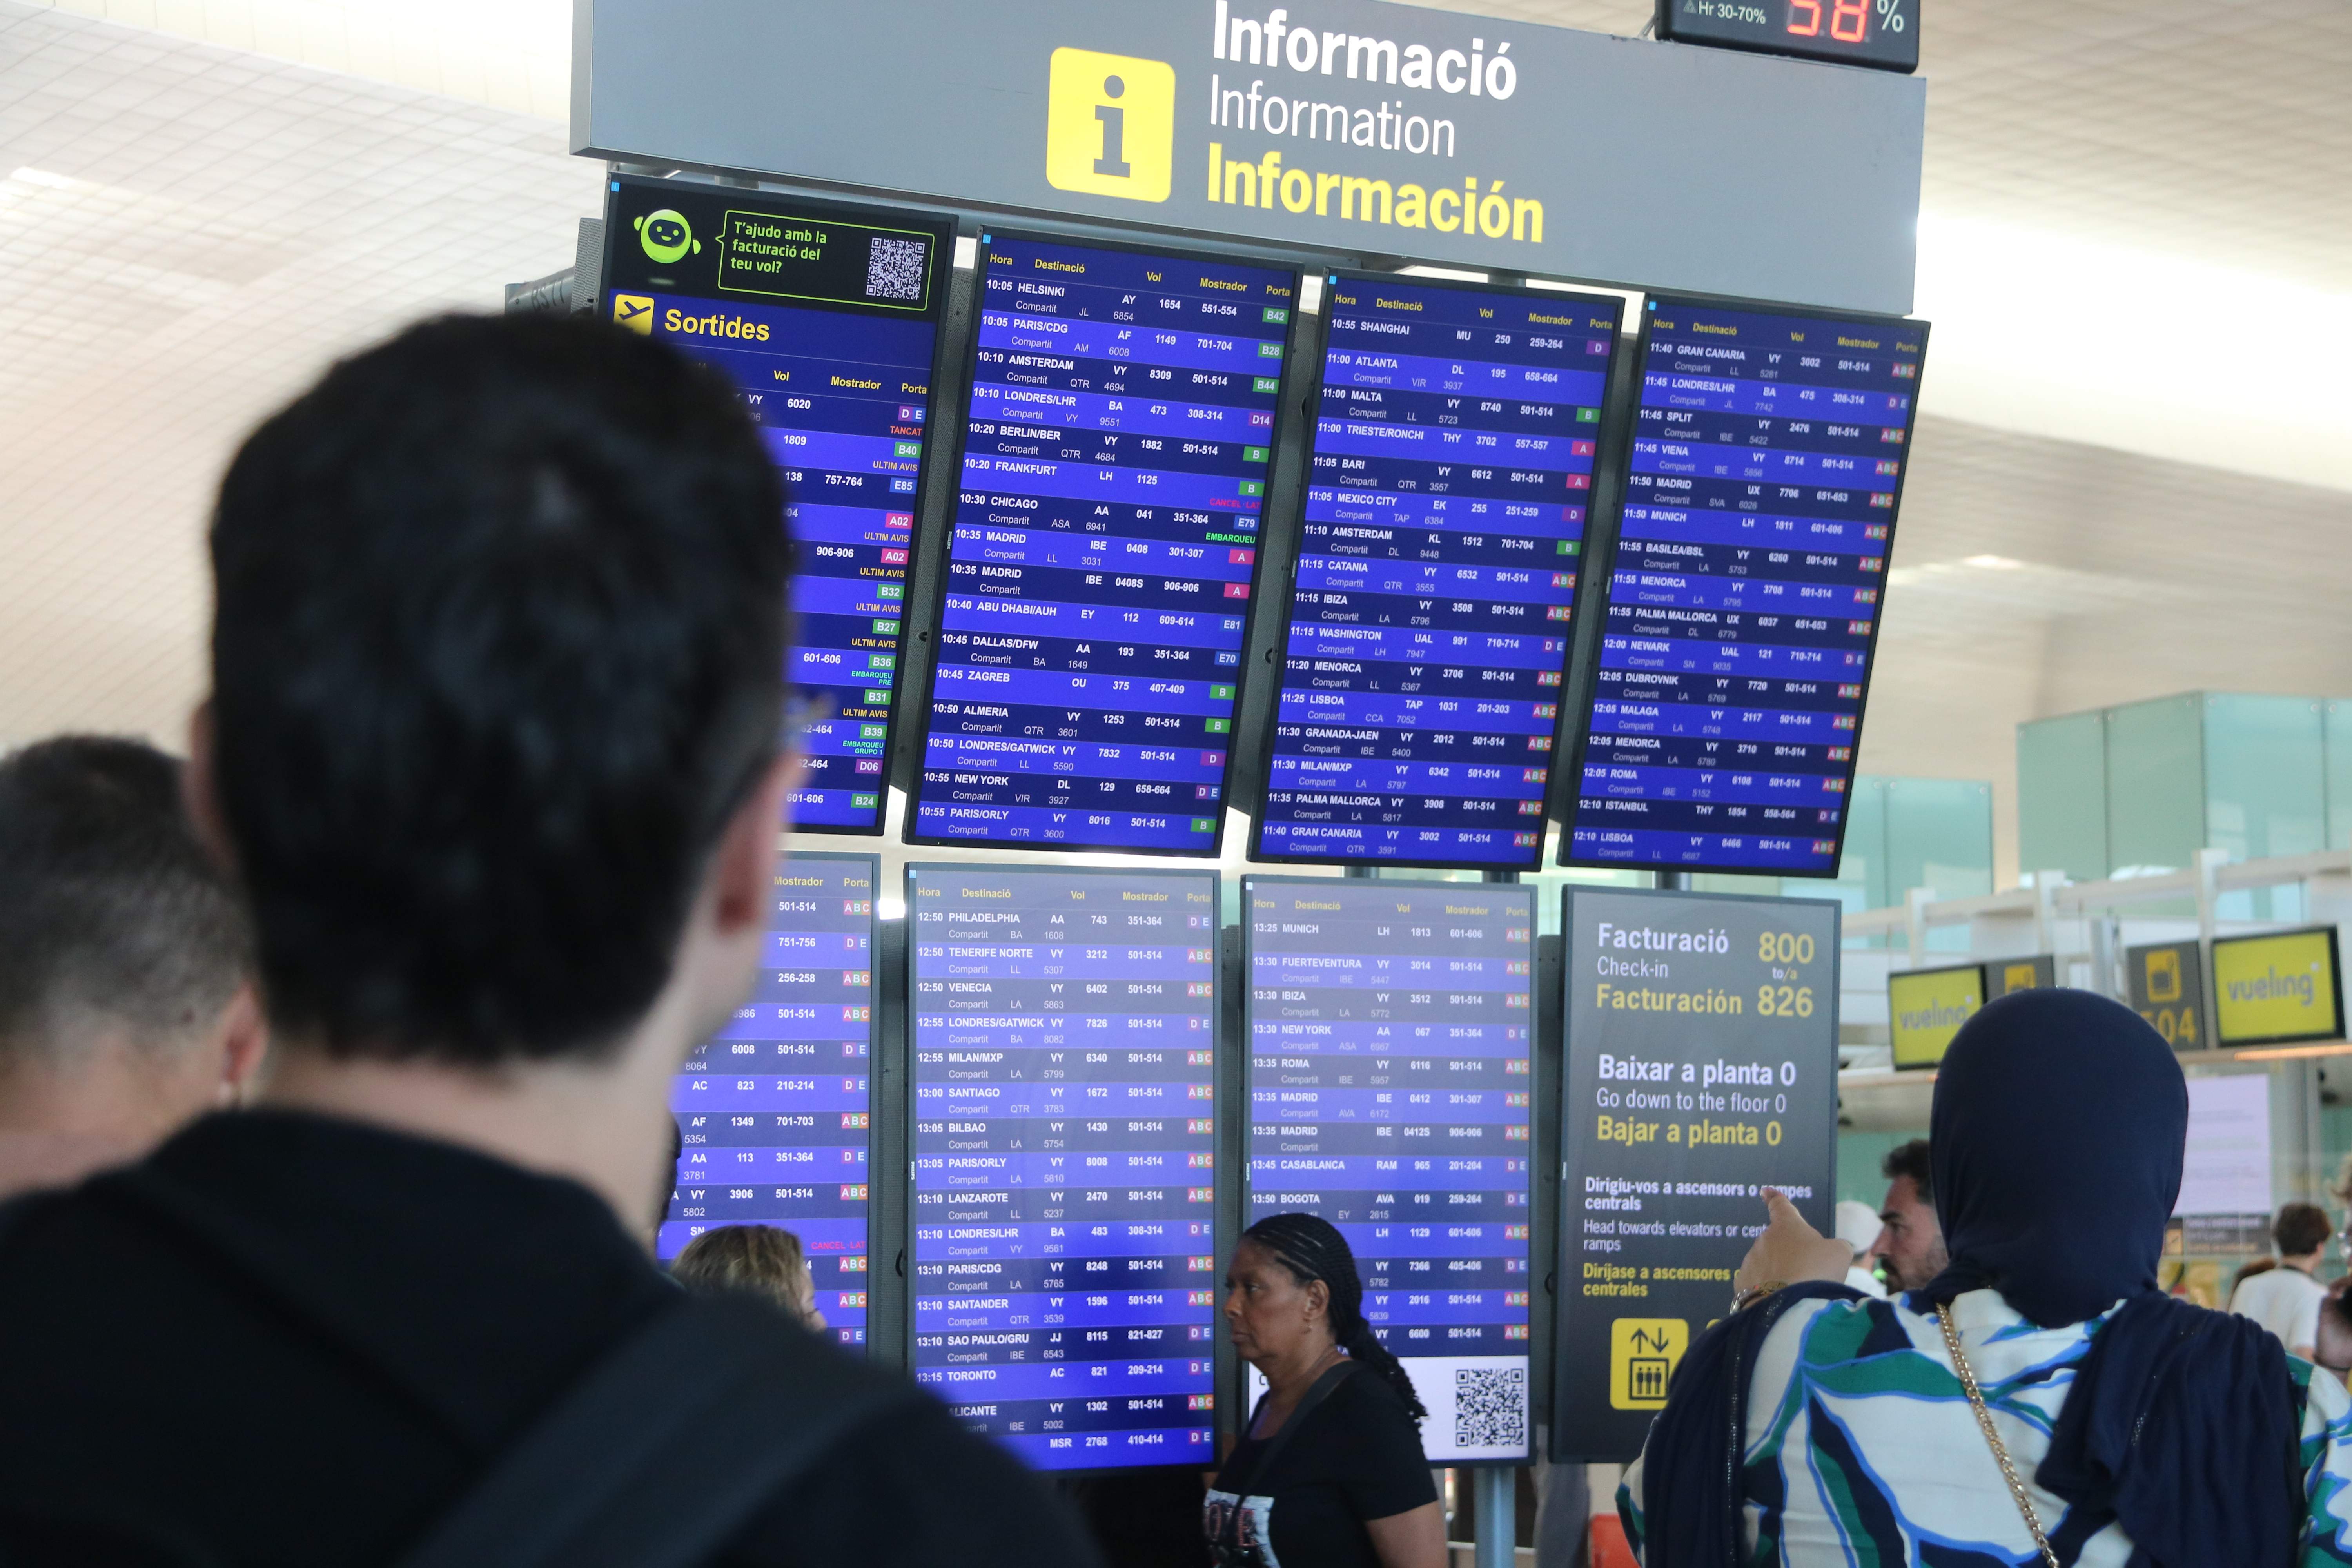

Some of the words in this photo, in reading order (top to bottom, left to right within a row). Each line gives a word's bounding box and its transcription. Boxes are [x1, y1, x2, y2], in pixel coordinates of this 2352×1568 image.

[1698, 2, 1713, 16] Hr
[1717, 4, 1766, 24] 30-70%
[1212, 0, 1518, 100] Informació
[1210, 74, 1456, 158] Information
[1208, 142, 1543, 243] Información
[785, 230, 812, 241] amb
[816, 231, 826, 243] la
[733, 239, 797, 257] facturació
[801, 247, 820, 260] del
[731, 258, 752, 270] teu
[757, 261, 782, 273] vol?
[990, 254, 1012, 265] Hora
[1035, 259, 1085, 273] Destinació
[1147, 272, 1161, 282] Vol
[1200, 278, 1247, 291] Mostrador
[1266, 285, 1290, 296] Porta
[987, 279, 1012, 290] 10:05
[1018, 283, 1064, 296] HELSINKI
[1122, 295, 1136, 304] AY
[1160, 299, 1180, 309] 1654
[1202, 304, 1236, 316] 551-554
[1267, 310, 1285, 321] B42
[1335, 294, 1356, 305] Hora
[1377, 298, 1422, 311] Destinació
[1480, 308, 1493, 318] Vol
[1529, 313, 1572, 325] Mostrador
[1016, 301, 1056, 313] Compartit
[1079, 308, 1088, 316] JL
[1114, 311, 1133, 321] 6854
[665, 309, 769, 341] Sortides
[1332, 319, 1356, 329] 10:55
[1361, 321, 1410, 334] SHANGHAI
[1457, 331, 1471, 340] MU
[1495, 334, 1510, 344] 250
[1530, 338, 1562, 348] 259-264
[983, 316, 1008, 327] 10:05
[1014, 319, 1067, 333] PARIS/CDG
[1118, 330, 1131, 339] AF
[1156, 334, 1176, 345] 1149
[1198, 339, 1232, 350] 701-704
[1262, 345, 1279, 356] B28
[774, 370, 789, 381] Vol
[831, 376, 881, 389] Mostrador
[902, 383, 927, 394] Porta
[1646, 376, 1667, 387] 11:45
[1672, 379, 1735, 393] LONDRES/LHR
[1763, 387, 1776, 396] BA
[1800, 390, 1815, 400] 475
[1833, 393, 1864, 404] 308-314
[749, 395, 763, 404] VY
[788, 398, 810, 409] 6020
[890, 426, 922, 436] TANCAT
[784, 435, 806, 445] 1809
[899, 445, 917, 455] B40
[873, 461, 897, 470] ULTIM
[899, 463, 917, 471] AVIS
[786, 472, 802, 481] 138
[826, 475, 862, 486] 757-764
[895, 481, 912, 490] E85
[817, 546, 853, 557] 906-906
[886, 552, 904, 561] A02
[804, 653, 840, 664] 601-606
[873, 657, 891, 666] B36
[1579, 800, 1601, 809] 12:10
[1606, 801, 1648, 811] ISTANBUL
[1696, 805, 1713, 814] THY
[1264, 826, 1286, 835] 11:40
[1292, 827, 1318, 836] GRAN
[1321, 828, 1362, 838] CANARIA
[1387, 831, 1399, 839] VY
[1419, 832, 1439, 841] 3002
[1458, 833, 1490, 842] 501-514
[775, 877, 823, 886] Mostrador
[844, 878, 869, 887] Porta
[918, 887, 940, 896] Hora
[962, 888, 1011, 898] Destinació
[1071, 891, 1084, 899] Vol
[1123, 892, 1168, 901] Mostrador
[1187, 893, 1210, 902] Porta
[779, 902, 816, 911] 501-514
[918, 912, 943, 921] 12:50
[949, 913, 1020, 922] PHILADELPHIA
[1051, 915, 1064, 923] AA
[1091, 916, 1107, 924] 743
[1128, 916, 1161, 925] 351-364
[1254, 923, 1277, 932] 13:25
[1283, 924, 1318, 933] MUNICH
[1411, 928, 1430, 936] 1813
[1450, 929, 1483, 938] 601-606
[1599, 923, 1728, 953] Facturació
[1759, 932, 1814, 964] 800
[1597, 956, 1668, 977] Check-in
[1772, 967, 1797, 981] to/a
[2227, 962, 2319, 1007] vueling
[1597, 984, 1742, 1014] Facturación
[1758, 985, 1813, 1017] 826
[2140, 1007, 2198, 1044] 04
[732, 1045, 755, 1054] 6008
[778, 1045, 815, 1054] 501-514
[1599, 1054, 1674, 1081] Baixar
[1682, 1063, 1694, 1082] a
[1703, 1059, 1772, 1088] planta
[1780, 1061, 1795, 1086] 0
[1597, 1087, 1619, 1107] Go
[1626, 1089, 1670, 1108] down
[1676, 1092, 1693, 1110] to
[1699, 1092, 1725, 1111] the
[1731, 1092, 1769, 1112] floor
[1775, 1094, 1786, 1113] 0
[692, 1117, 706, 1126] AF
[731, 1117, 754, 1126] 1349
[777, 1116, 813, 1125] 701-703
[1598, 1115, 1659, 1146] Bajar
[1667, 1124, 1680, 1142] a
[1689, 1119, 1758, 1148] planta
[1766, 1121, 1781, 1145] 0
[1252, 1160, 1276, 1169] 13:45
[1281, 1160, 1345, 1169] CASABLANCA
[1377, 1161, 1397, 1169] RAM
[1415, 1161, 1430, 1170] 965
[1449, 1161, 1481, 1170] 201-204
[1586, 1177, 1659, 1196] Dirigiu-vos
[1663, 1182, 1671, 1194] a
[1676, 1183, 1744, 1196] ascensors
[1748, 1185, 1757, 1196] o
[1585, 1194, 1641, 1210] centrals
[1584, 1219, 1615, 1234] Head
[1619, 1220, 1665, 1235] towards
[1669, 1221, 1722, 1236] elevators
[1726, 1225, 1738, 1237] or
[1584, 1239, 1621, 1252] ramps
[1584, 1263, 1636, 1281] Diríjase
[1640, 1267, 1649, 1279] a
[1653, 1268, 1730, 1280] ascensores
[1583, 1281, 1648, 1296] centrales
[917, 1372, 942, 1381] 13:15
[947, 1370, 996, 1381] TORONTO
[1050, 1368, 1064, 1377] AC
[1091, 1367, 1107, 1376] 821
[1128, 1365, 1163, 1374] 209-214
